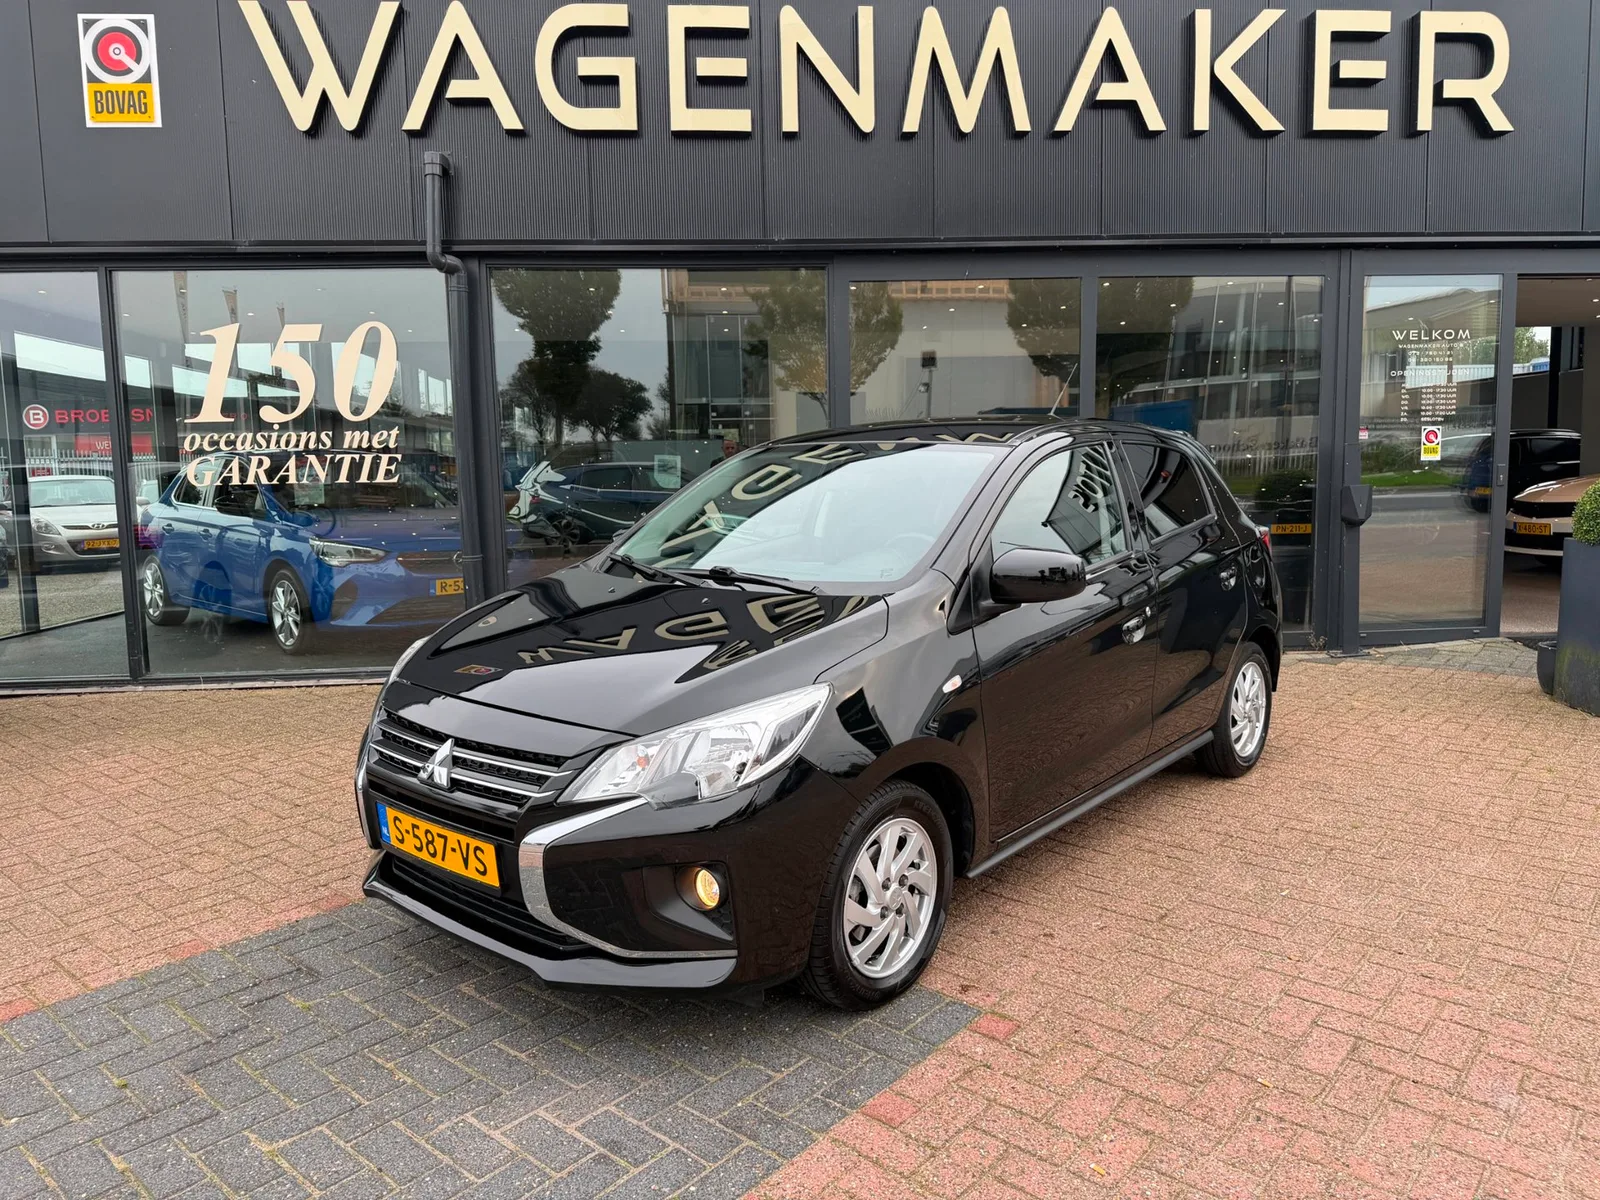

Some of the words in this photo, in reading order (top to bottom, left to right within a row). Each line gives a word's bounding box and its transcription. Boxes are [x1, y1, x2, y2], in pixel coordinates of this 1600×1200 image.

[238, 0, 1514, 134] WAGENMAKER
[94, 90, 149, 116] BOVAG
[1392, 329, 1471, 341] WELKOM
[184, 320, 398, 423] 150
[30, 410, 44, 424] B
[184, 424, 333, 452] occasions
[344, 426, 400, 449] met
[186, 453, 402, 486] GARANTIE
[382, 826, 390, 837] NL
[393, 816, 487, 876] S-587-VS
